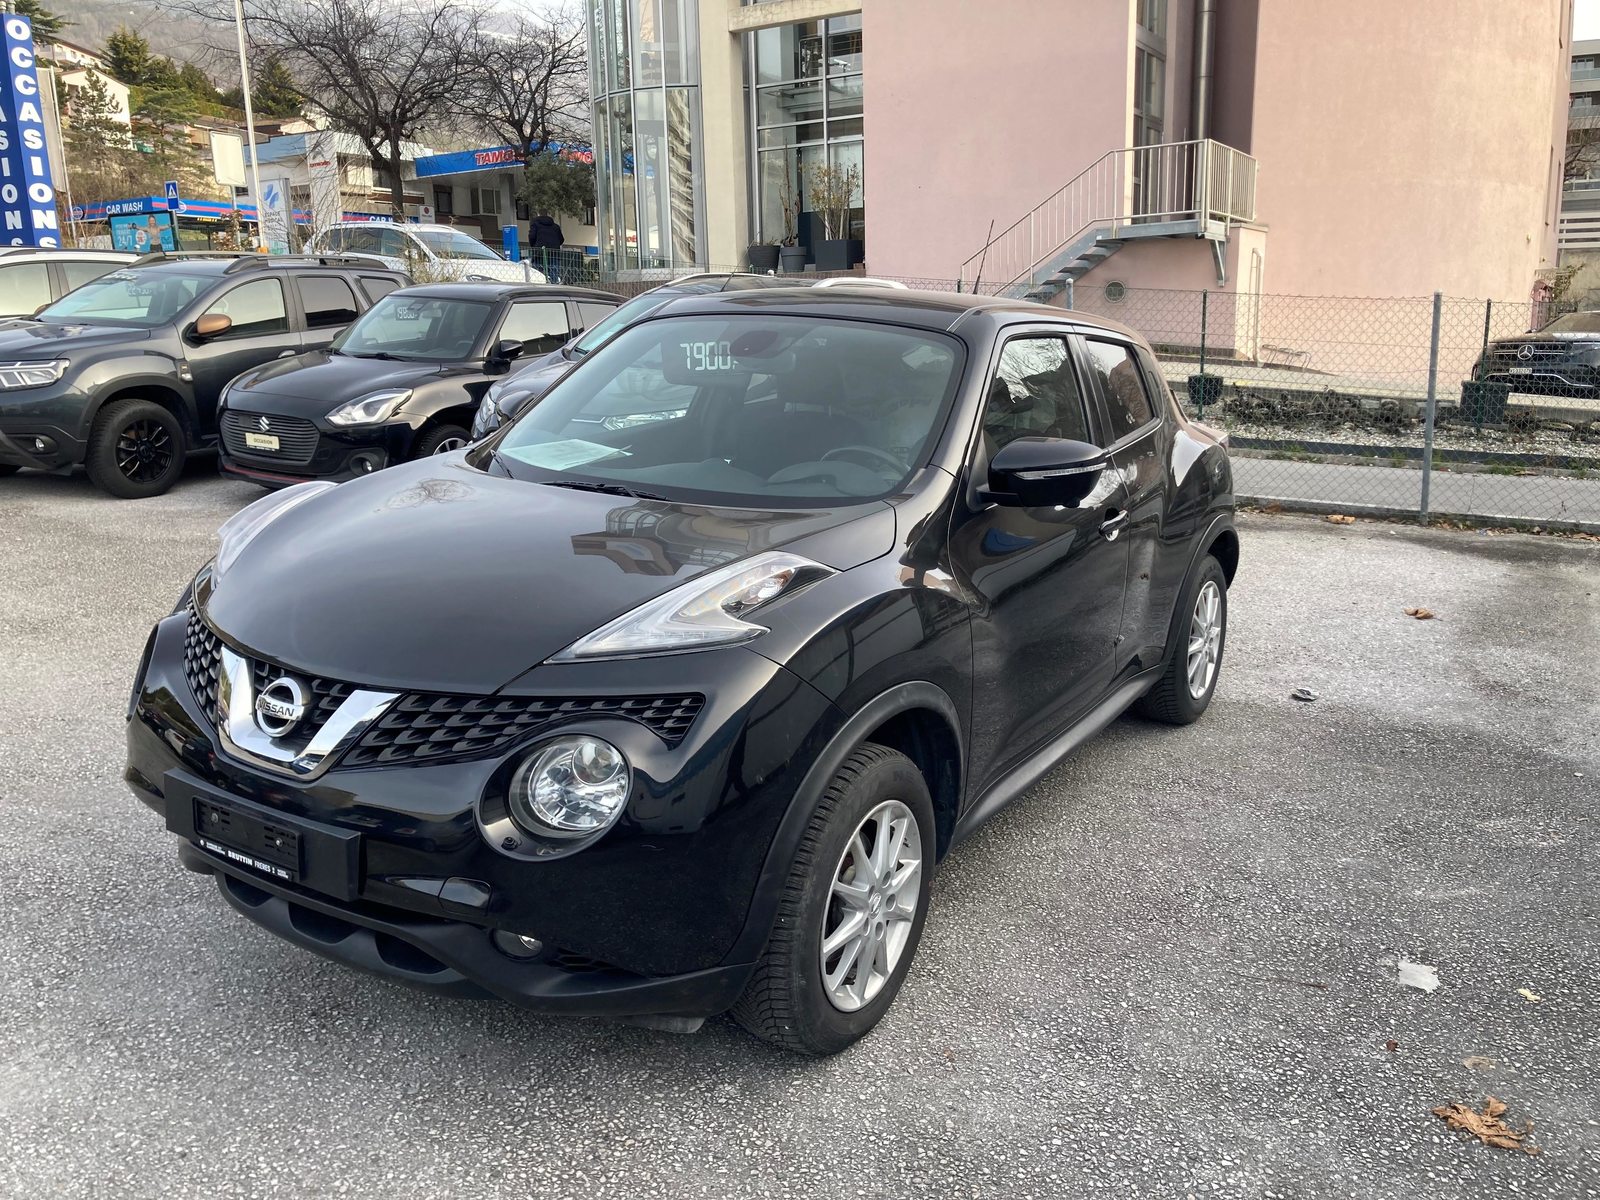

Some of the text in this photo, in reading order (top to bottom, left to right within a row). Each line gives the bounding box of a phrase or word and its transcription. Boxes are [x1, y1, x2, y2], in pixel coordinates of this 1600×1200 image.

[106, 202, 143, 215] CAR WASH
[257, 698, 295, 717] NISSAN
[228, 850, 253, 866] BRUTTIN
